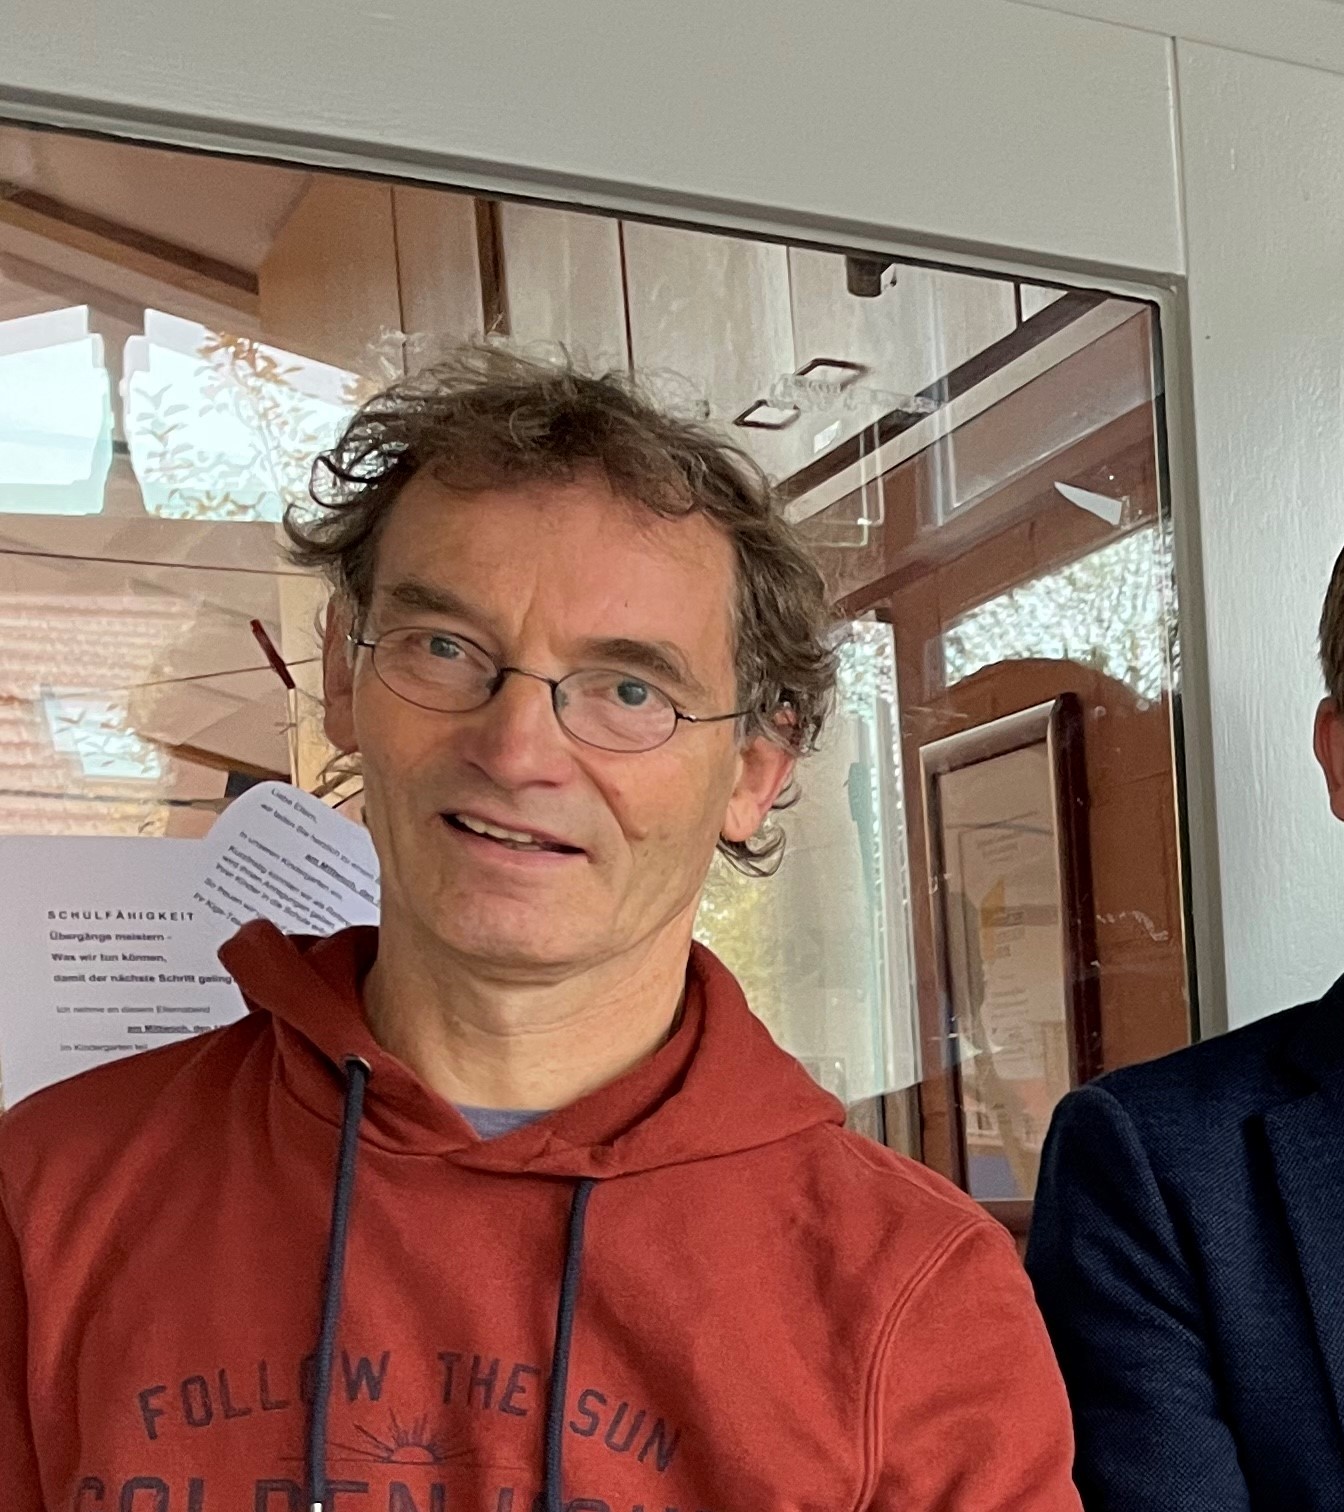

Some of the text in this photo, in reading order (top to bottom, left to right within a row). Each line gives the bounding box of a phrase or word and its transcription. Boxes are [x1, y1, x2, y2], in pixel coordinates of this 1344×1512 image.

[47, 909, 195, 922] SCHULFÄHIGKEIT
[137, 1349, 682, 1473] FOLLW THE SUN
